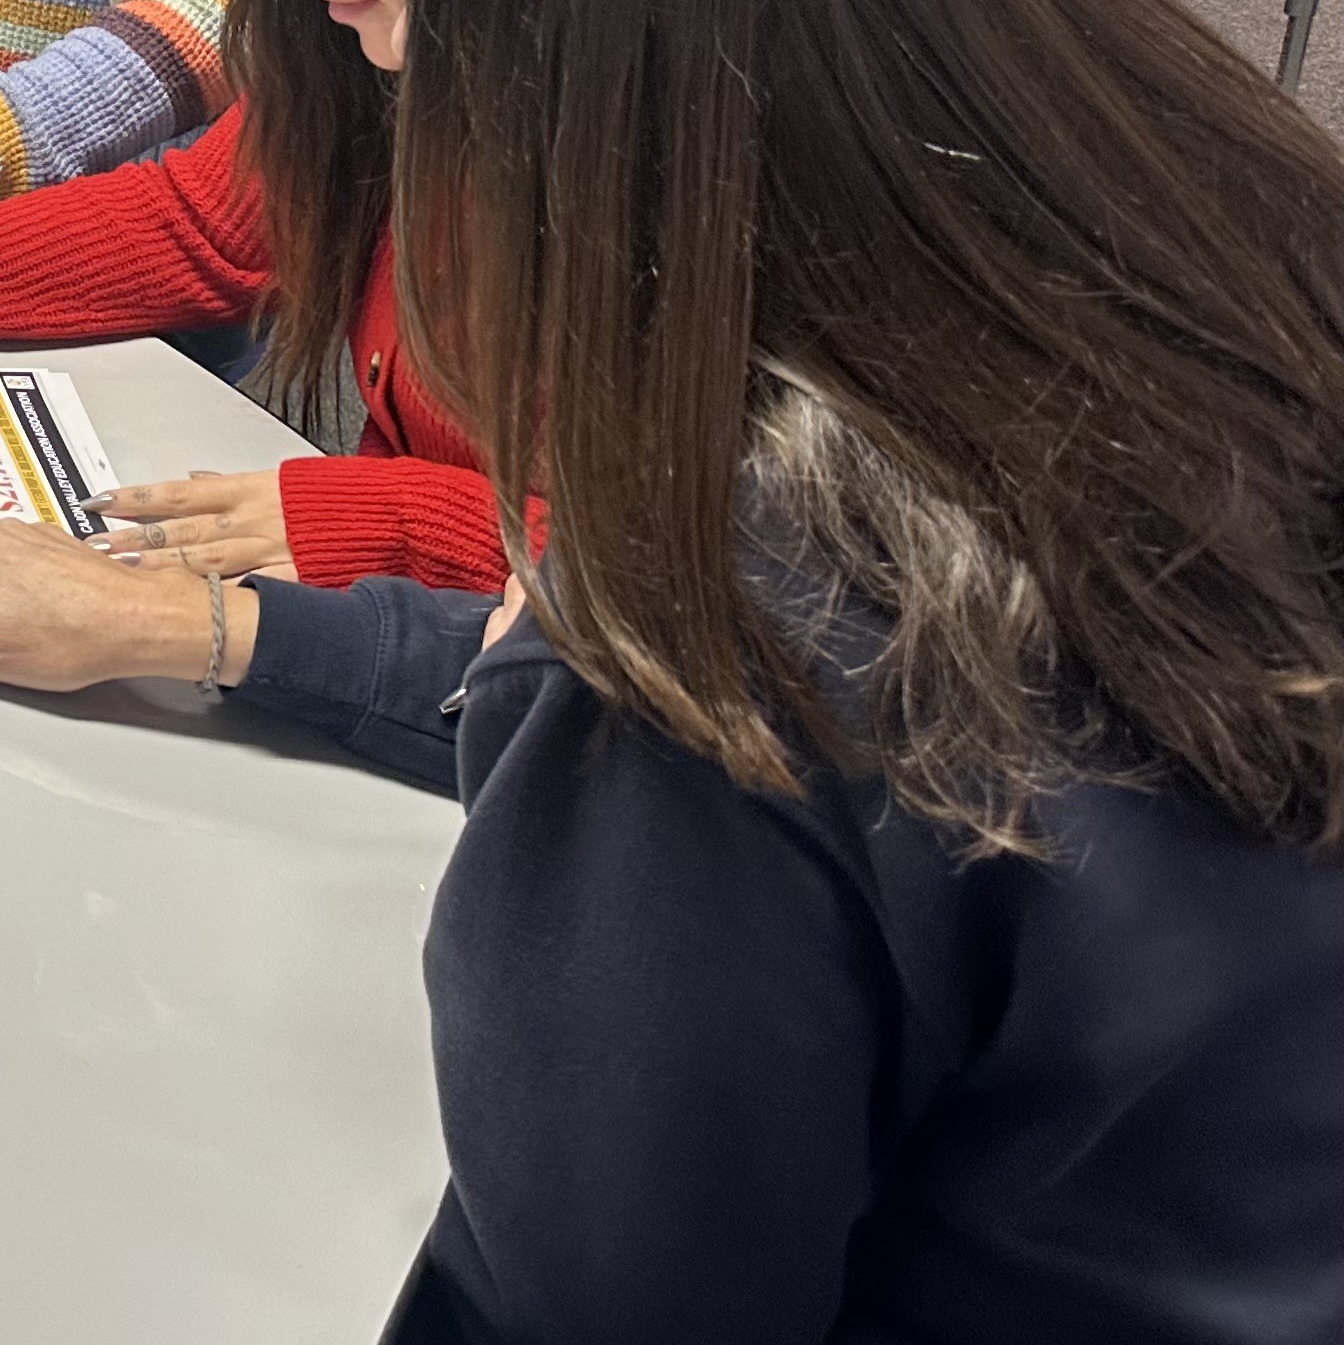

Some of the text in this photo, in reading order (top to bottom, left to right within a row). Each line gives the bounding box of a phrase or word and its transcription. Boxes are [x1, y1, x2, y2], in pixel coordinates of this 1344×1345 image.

[17, 391, 49, 441] ASSOCIATION
[40, 440, 71, 484] EDUCATION
[70, 507, 94, 534] CAJON
